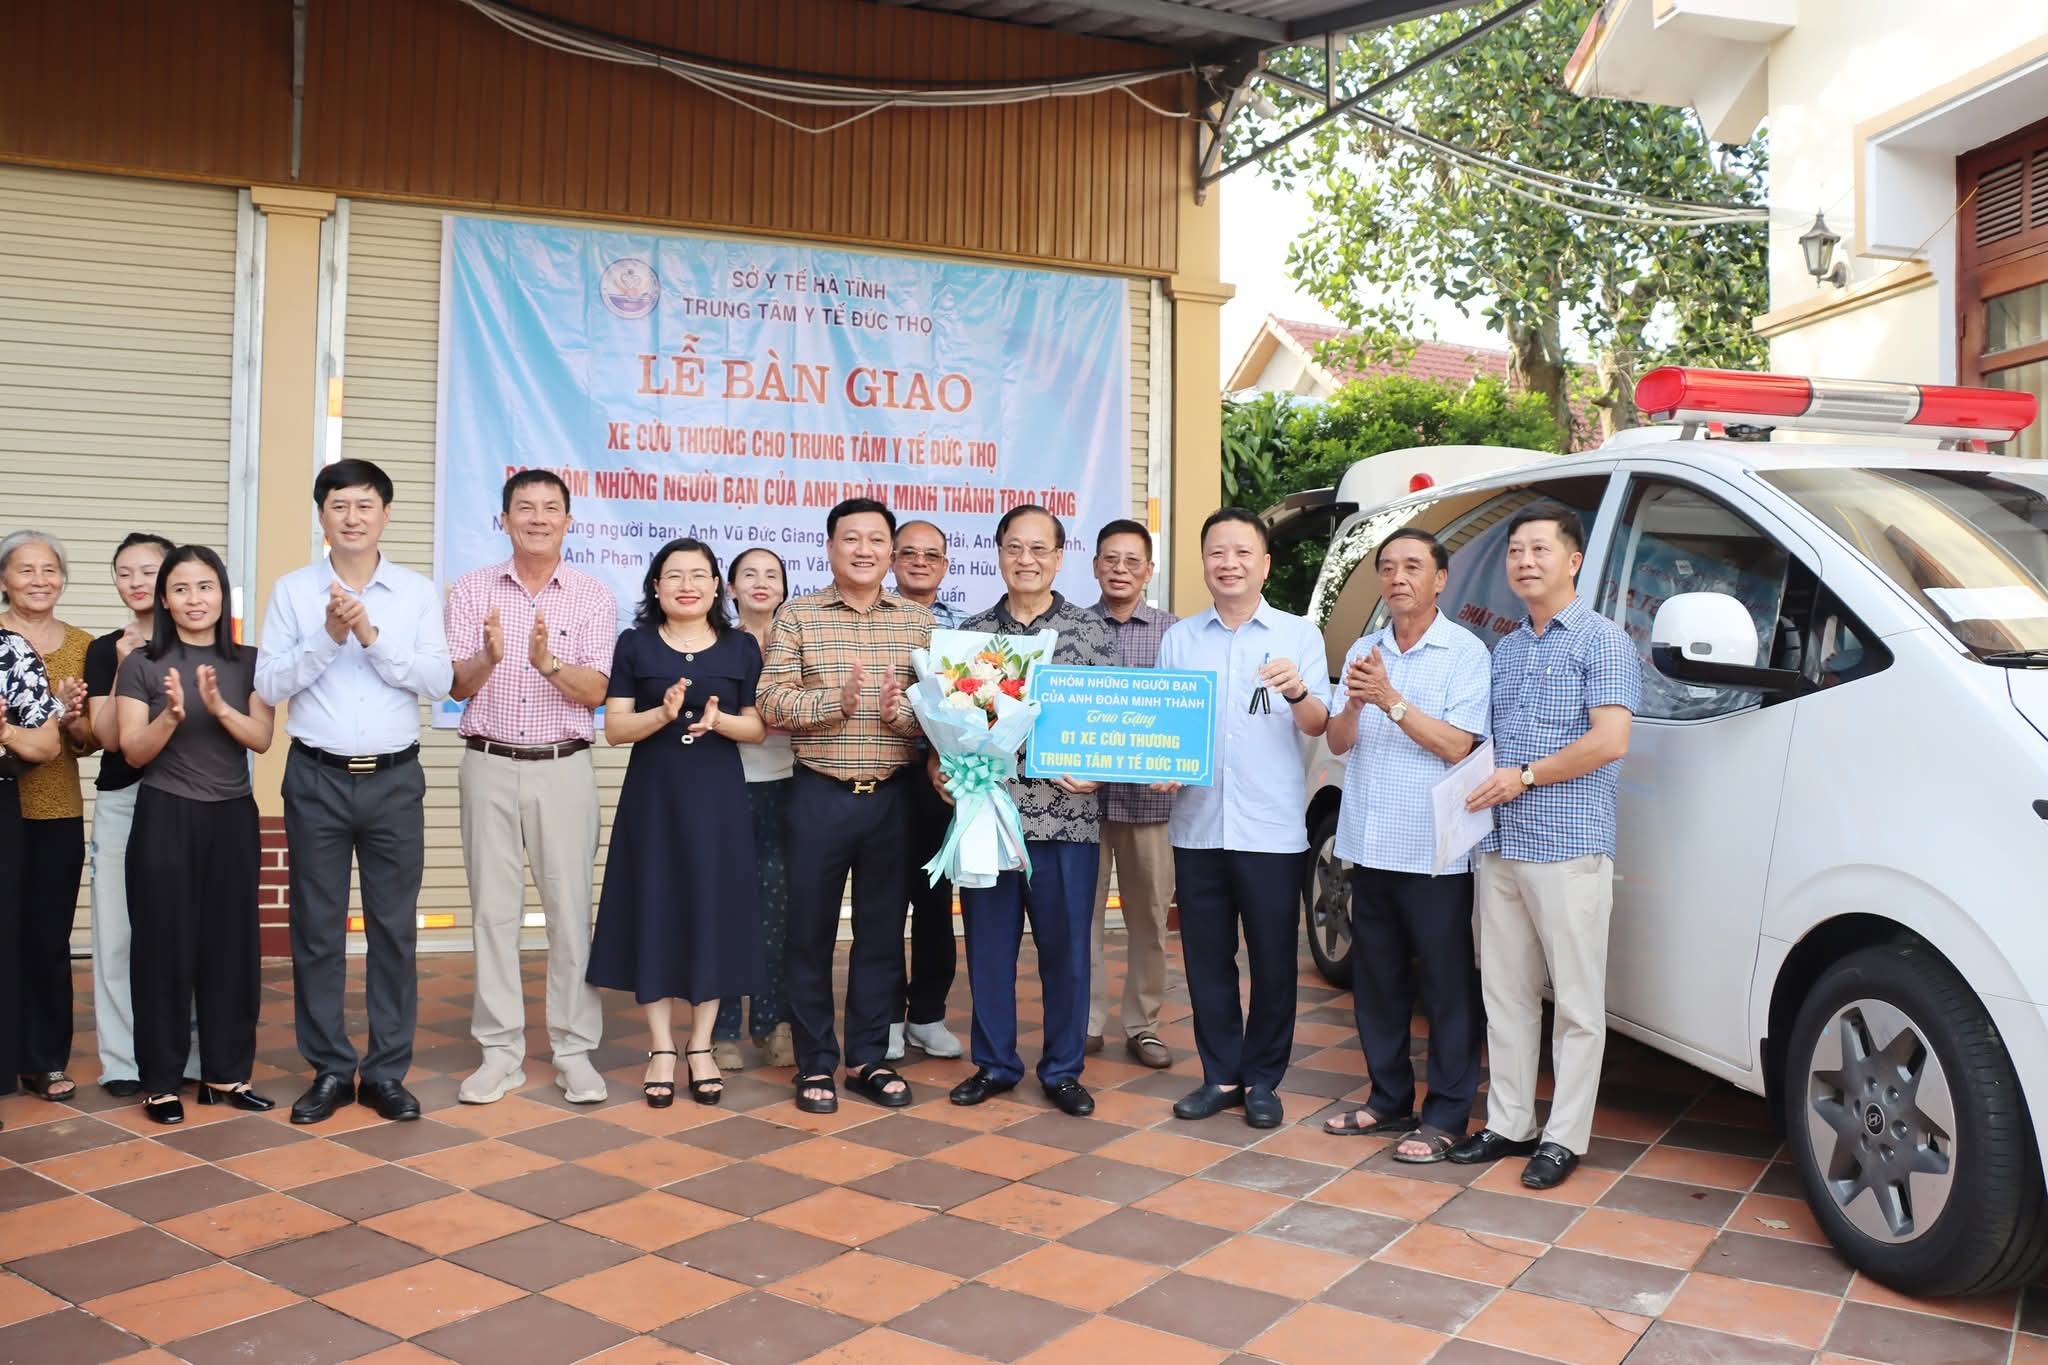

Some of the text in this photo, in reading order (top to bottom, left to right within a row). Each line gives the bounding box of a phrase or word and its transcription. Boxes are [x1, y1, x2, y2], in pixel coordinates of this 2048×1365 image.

[732, 264, 886, 300] SỞ Y TẾ HÀ TĨNH
[683, 297, 933, 337] TRUNG TÂM Y TẾ ĐỨC THỌ
[637, 333, 974, 414] LỄ BÀN GIAO
[608, 422, 630, 450] XE
[677, 425, 746, 456] THƯƠNG
[752, 430, 785, 458] CHO
[790, 432, 844, 460] TRUNG
[850, 431, 886, 463] TÂM
[892, 437, 902, 463] Y
[907, 431, 926, 464] TẾ
[930, 434, 962, 466] ĐỨC
[967, 441, 996, 474] THỌ
[595, 466, 658, 501] NHỮNG
[663, 468, 717, 503] NGƯỜI
[723, 477, 758, 510] BẠN
[764, 470, 797, 506] CỦA
[802, 480, 837, 508] ANH
[893, 484, 938, 512] MINH
[942, 482, 995, 514] THÀNH
[600, 520, 643, 541] người
[688, 524, 718, 541] Anh
[724, 524, 743, 541] Vũ
[749, 524, 777, 542] Đức
[781, 528, 825, 548] Giang
[564, 547, 595, 563] Anh
[601, 550, 643, 568] Phạm
[970, 559, 997, 576] Hữu
[936, 585, 966, 603] uấn
[1050, 675, 1197, 694] NHÓM NHỮNG NGƯỜI BẠN
[1041, 689, 1205, 709] CỦA ANH ĐOÀN MINH THÀNH
[1086, 710, 1157, 728] Trao Tặng
[1061, 731, 1076, 745] 01
[1080, 731, 1096, 745] XE
[1129, 733, 1180, 749] THƯƠNG
[1040, 751, 1200, 775] TRUNG TÂM Y TẾ ĐỨC THỌ
